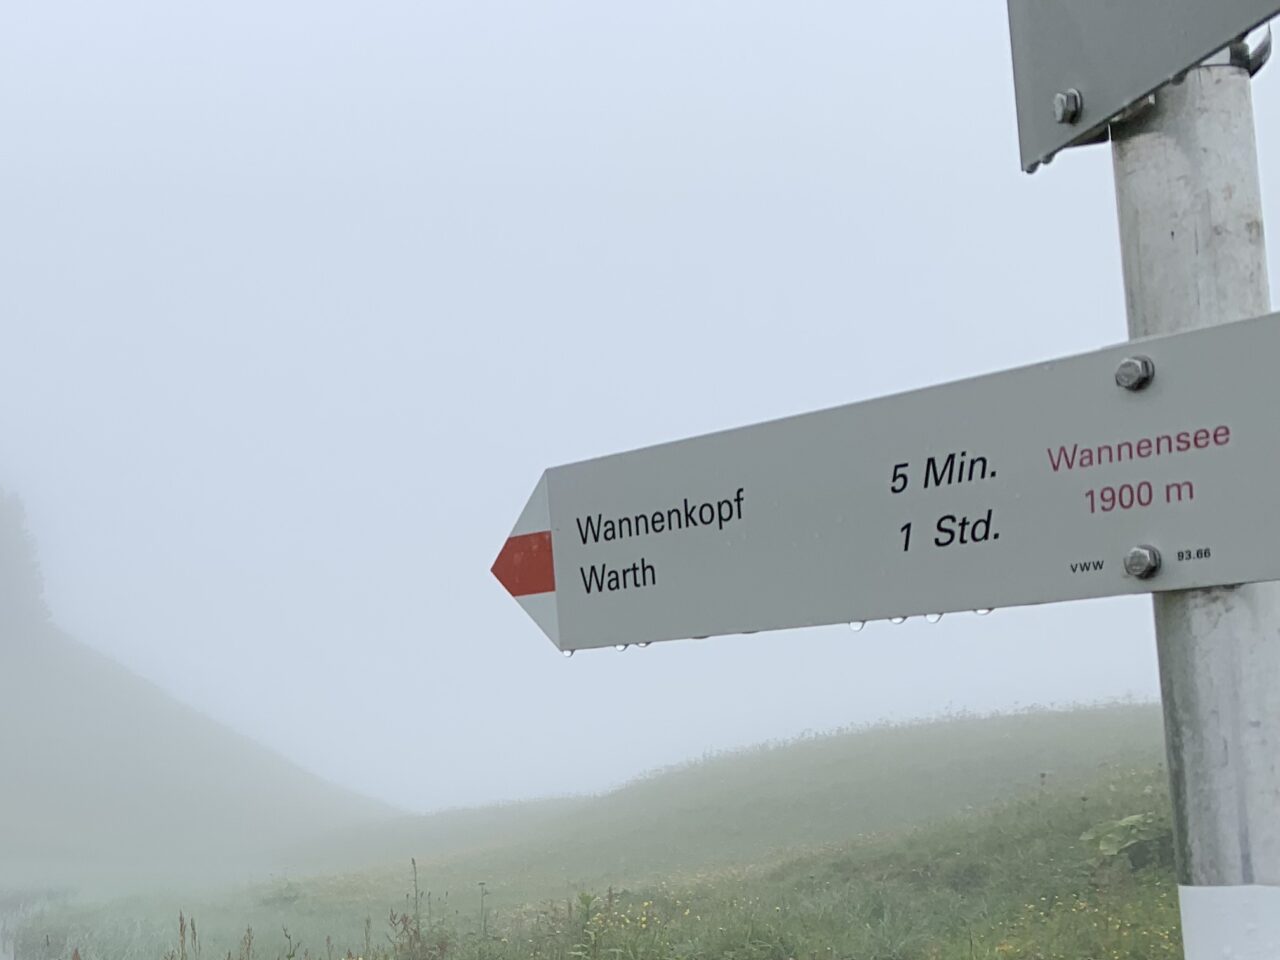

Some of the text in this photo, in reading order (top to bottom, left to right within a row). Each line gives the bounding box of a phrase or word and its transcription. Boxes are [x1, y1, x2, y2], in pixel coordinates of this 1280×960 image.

[1048, 425, 1231, 471] Wannensee
[576, 451, 997, 545] Wannenkopf 5 Min.
[1085, 481, 1193, 513] 1900 m
[580, 509, 1000, 595] Warth 1 Std.
